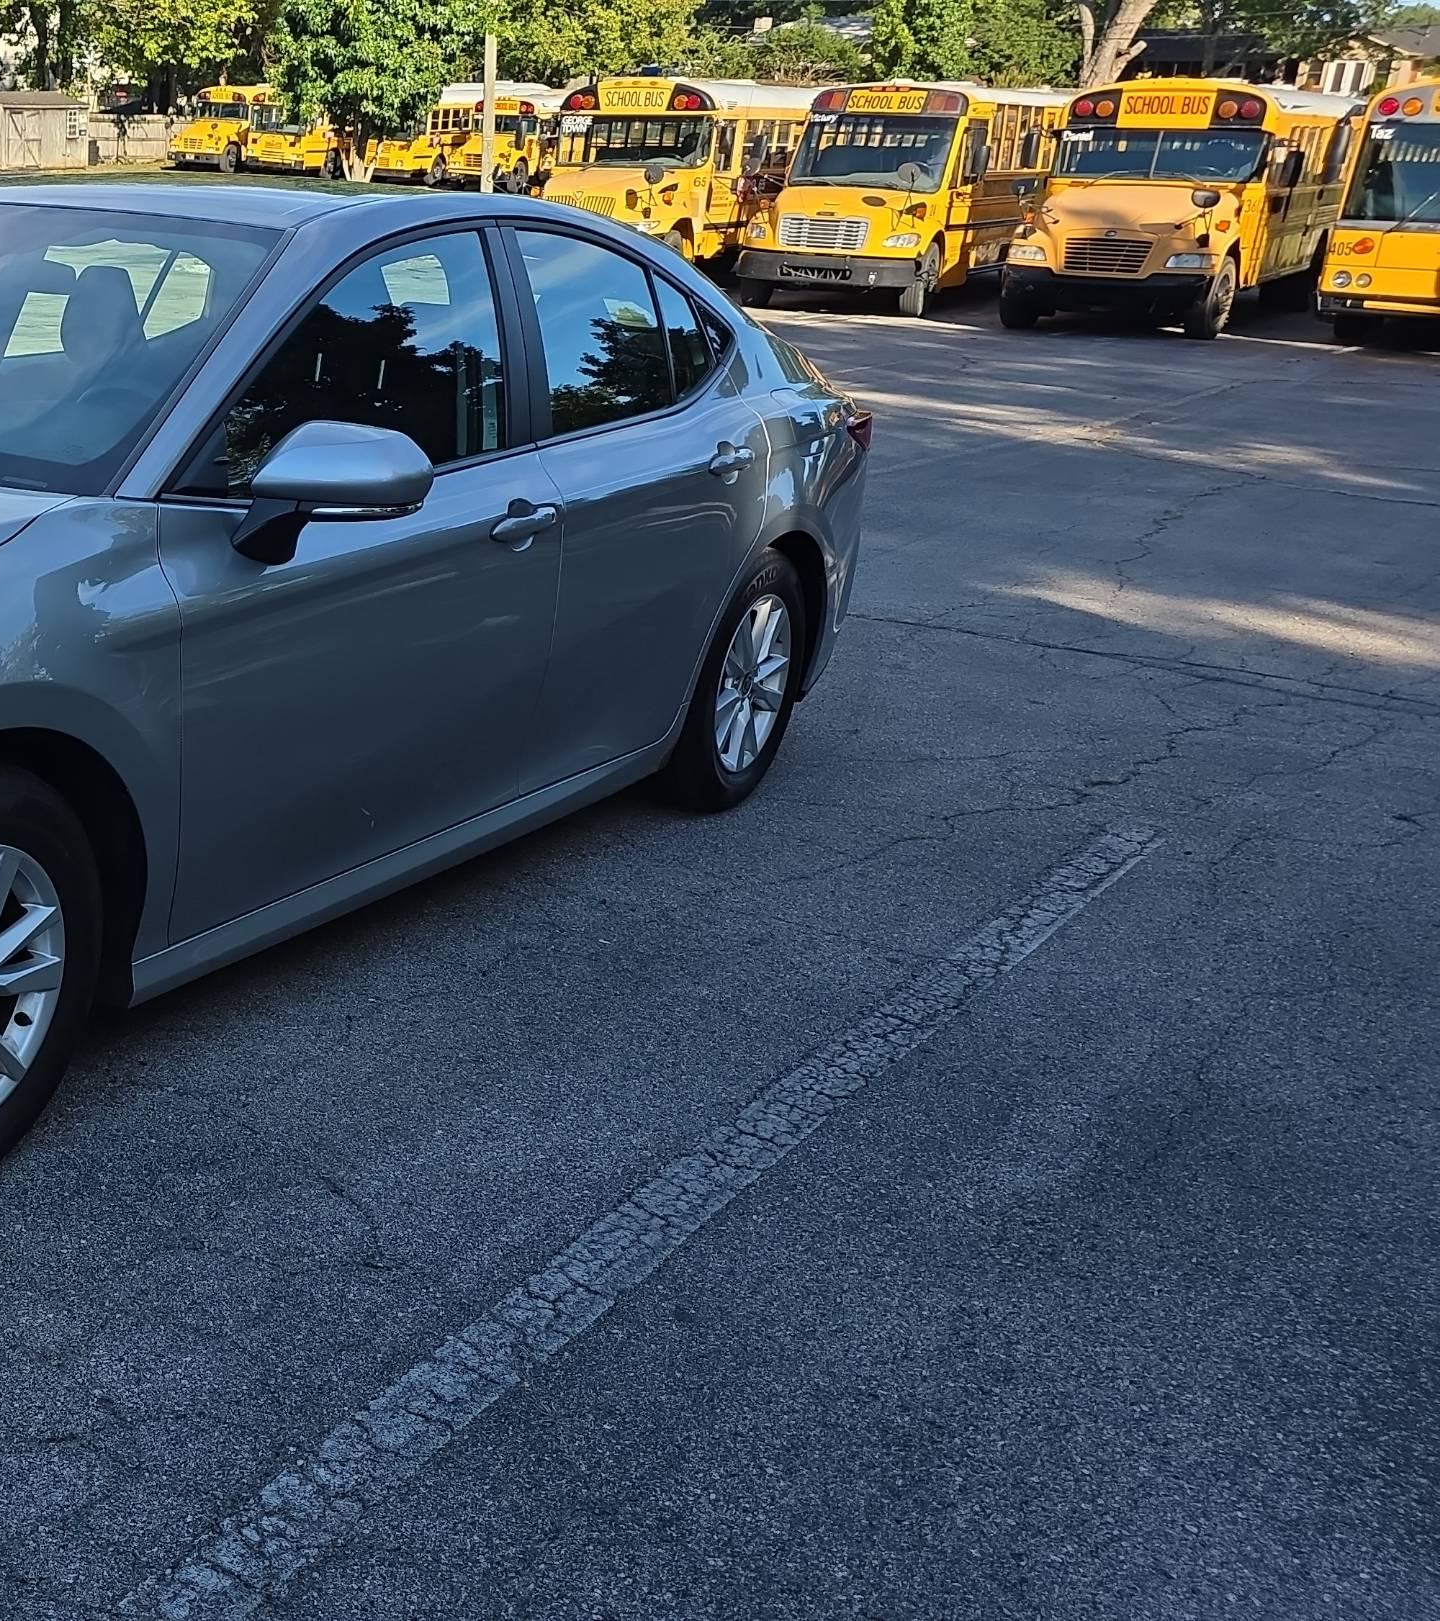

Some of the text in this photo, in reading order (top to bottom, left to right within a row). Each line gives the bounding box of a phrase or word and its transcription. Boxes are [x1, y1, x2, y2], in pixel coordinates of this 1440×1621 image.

[605, 91, 665, 107] SCHOOL BUS
[848, 95, 925, 110] SCHOOL BUS
[1124, 95, 1211, 115] SCHOOL BUS
[562, 115, 594, 126] GEORGE
[562, 125, 589, 134] TOWN
[1062, 130, 1095, 141] Daniel
[1370, 124, 1396, 139] Taz
